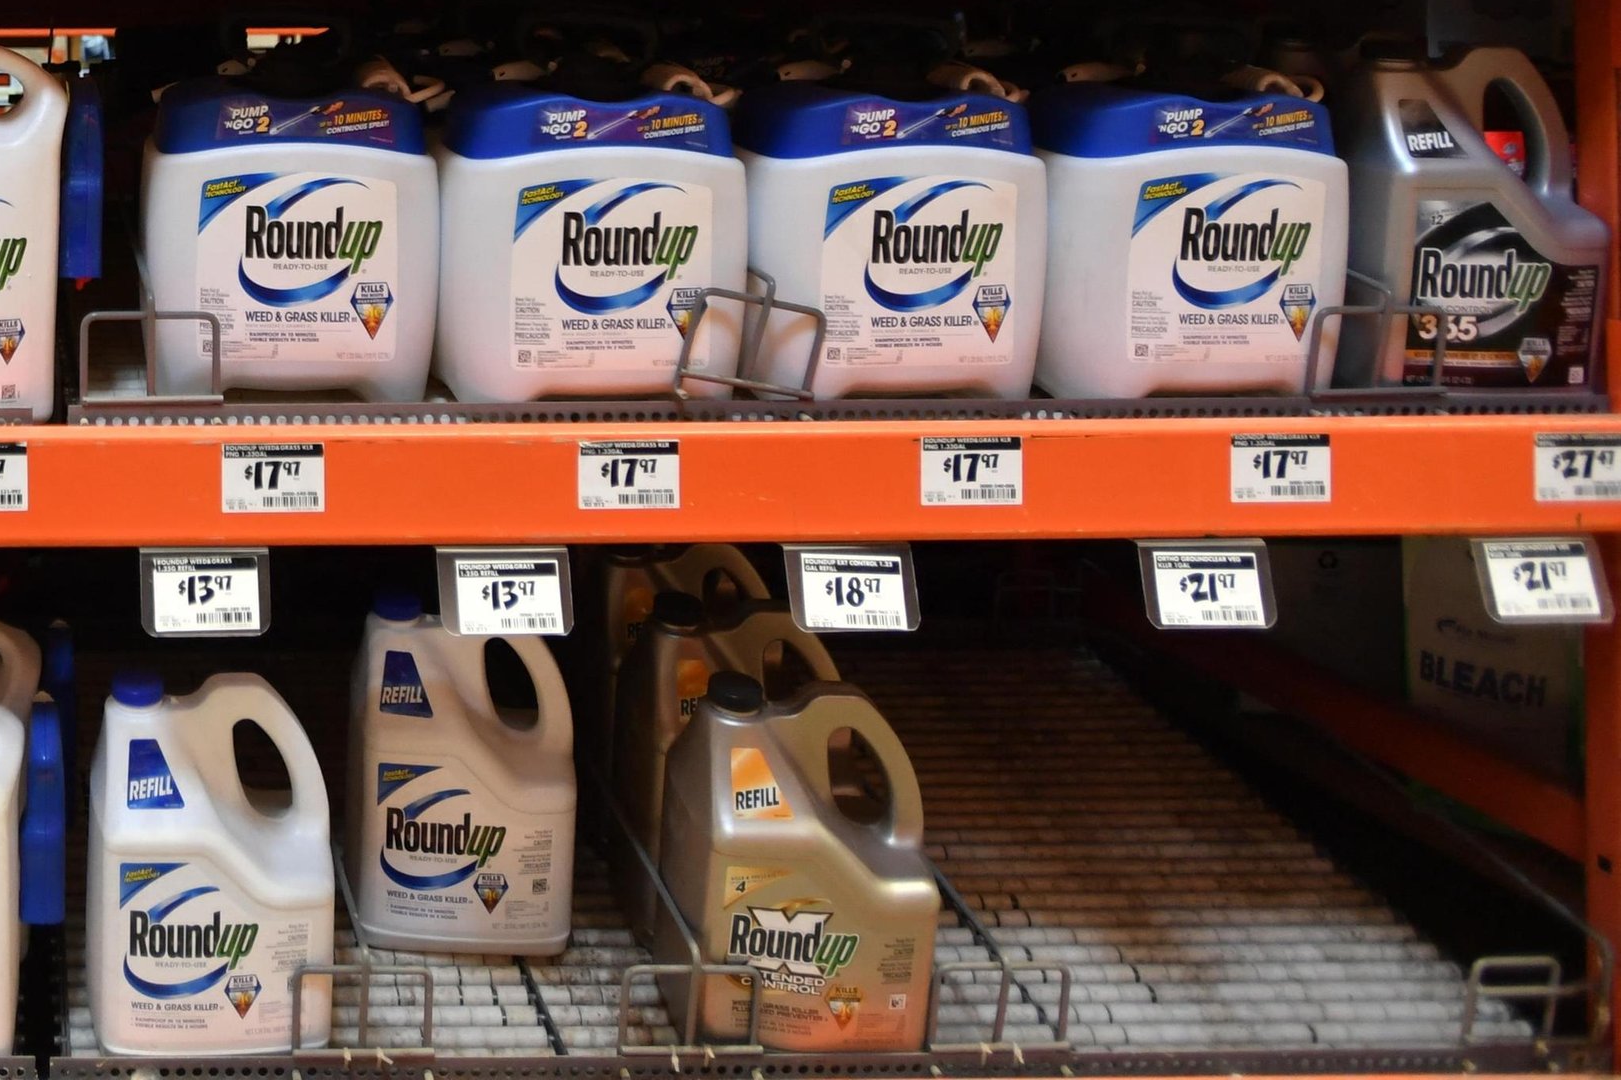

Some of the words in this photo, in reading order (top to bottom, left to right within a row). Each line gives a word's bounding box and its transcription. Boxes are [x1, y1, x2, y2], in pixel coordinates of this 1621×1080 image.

[232, 105, 269, 120] PUMP
[257, 117, 270, 132] 2
[334, 115, 345, 125] 10
[346, 110, 383, 124] MINUTES
[1407, 131, 1454, 151] REFILL
[245, 205, 383, 274] Roundup
[562, 211, 699, 280] Roundup
[871, 209, 1004, 278] Roundup
[1180, 207, 1312, 275] Roundup
[1419, 247, 1552, 314] Roundup
[382, 686, 423, 704] REFILL
[1419, 650, 1547, 707] BLEACH
[130, 776, 173, 801] REFILL
[736, 787, 780, 810] REFILL
[386, 807, 506, 869] Roundup
[130, 910, 259, 970] Roundup
[729, 914, 860, 978] Roundup
